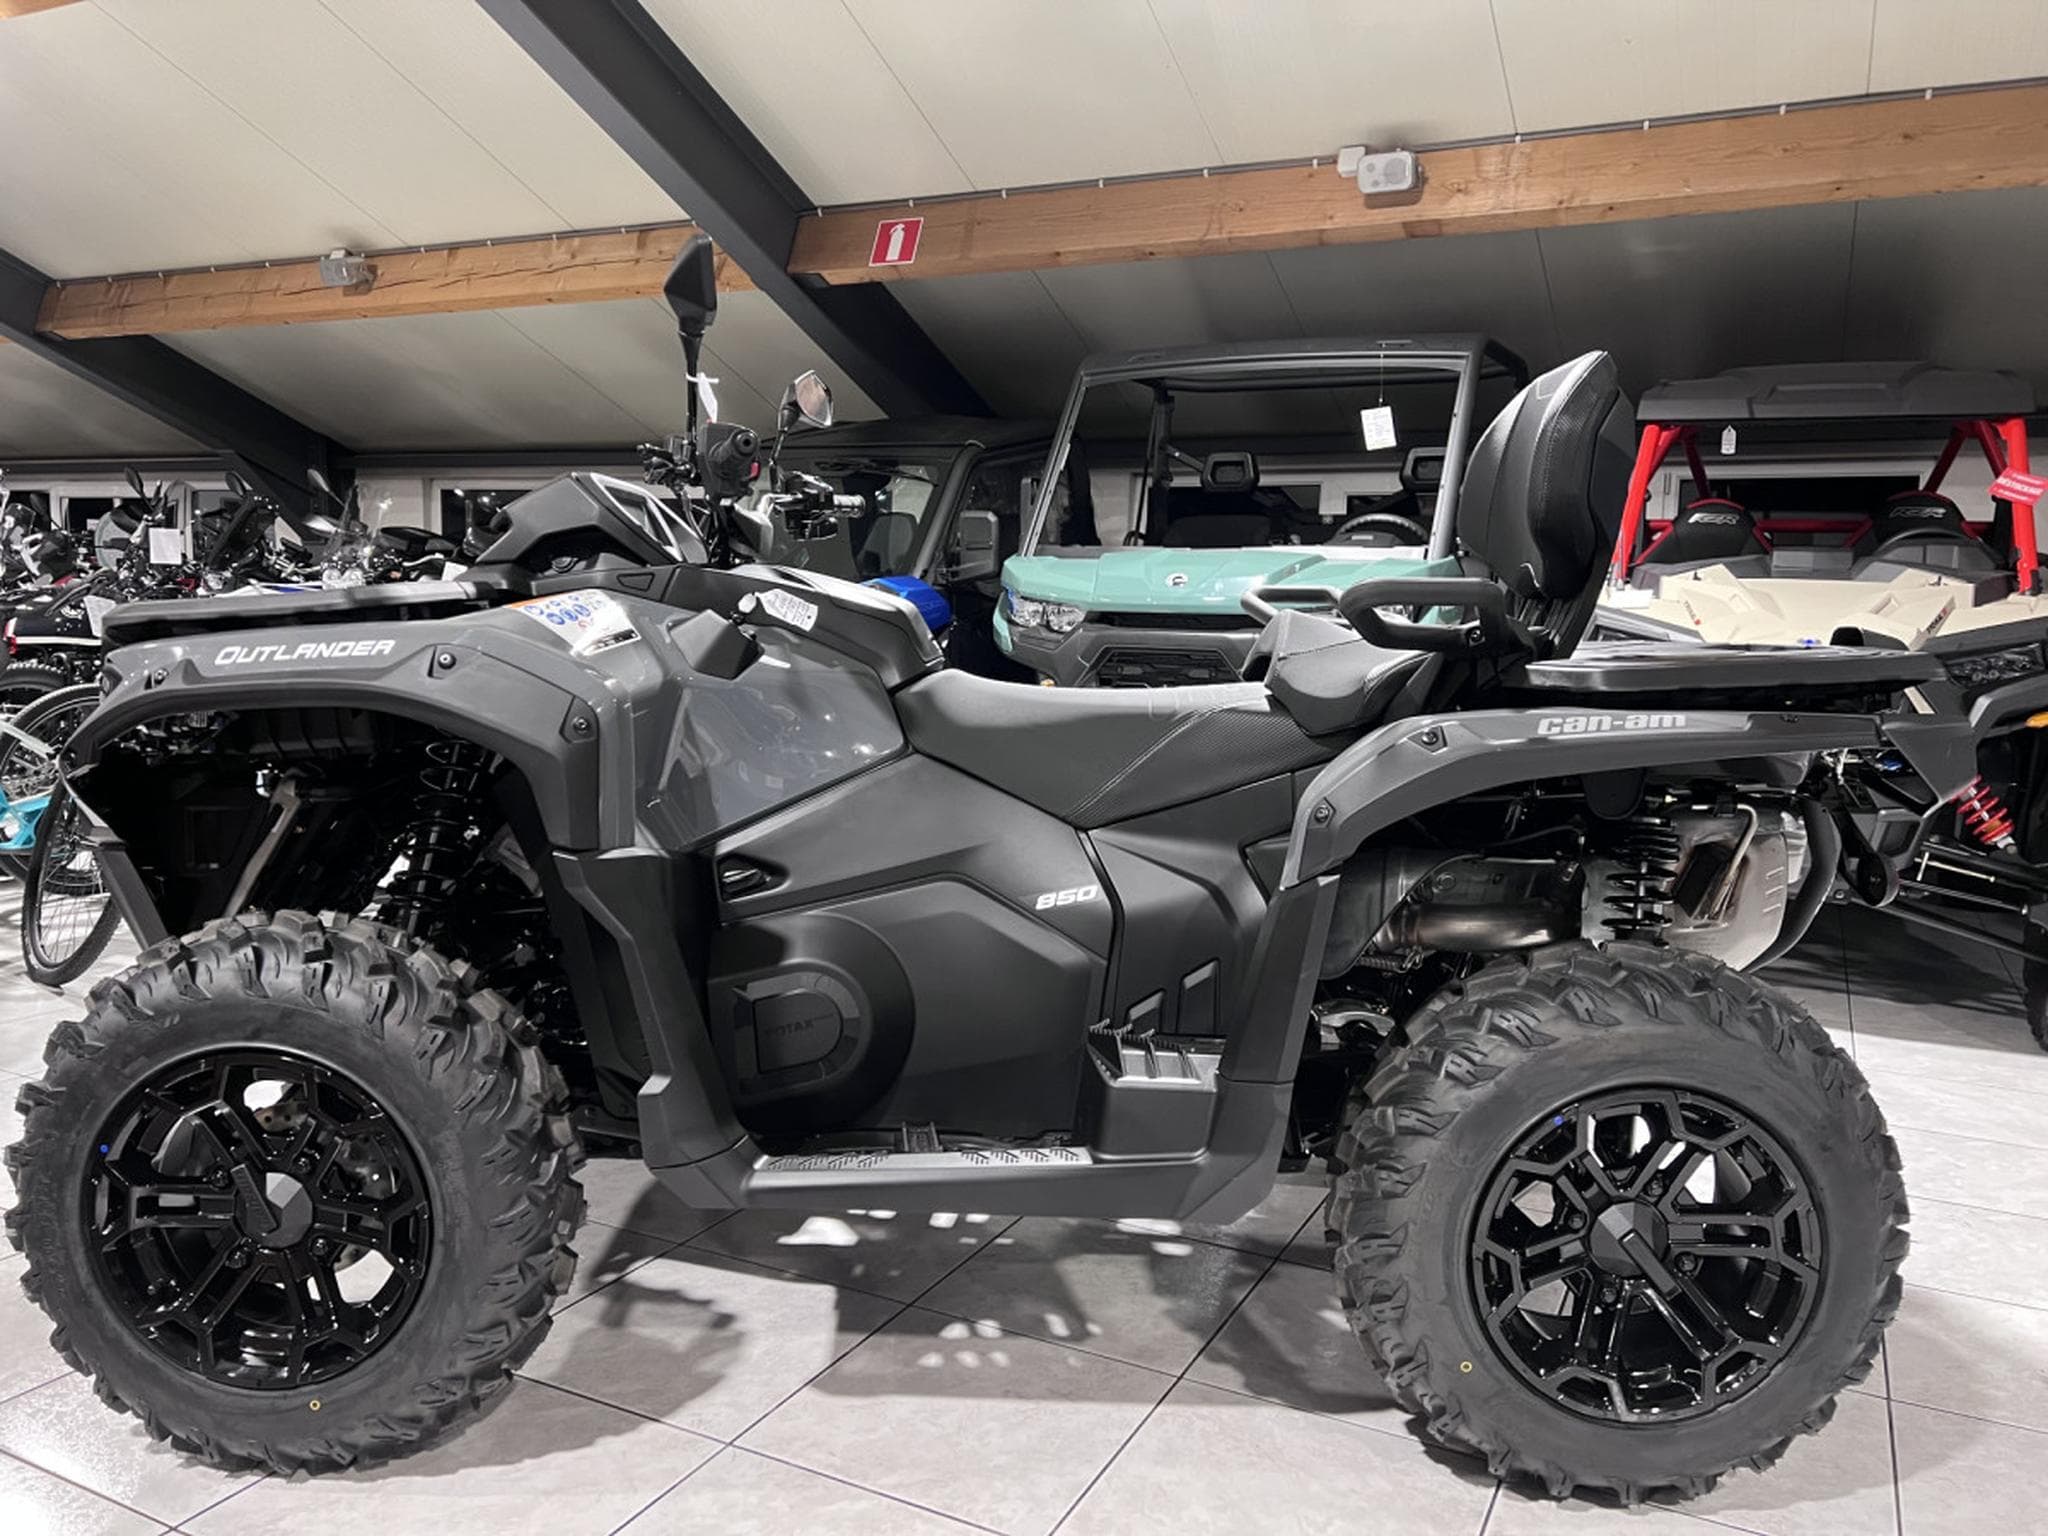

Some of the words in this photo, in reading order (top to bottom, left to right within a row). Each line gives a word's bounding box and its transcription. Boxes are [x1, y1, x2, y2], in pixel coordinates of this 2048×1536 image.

[214, 639, 396, 665] OUTLANDER
[1537, 714, 1686, 735] can-am
[1035, 885, 1098, 910] 850
